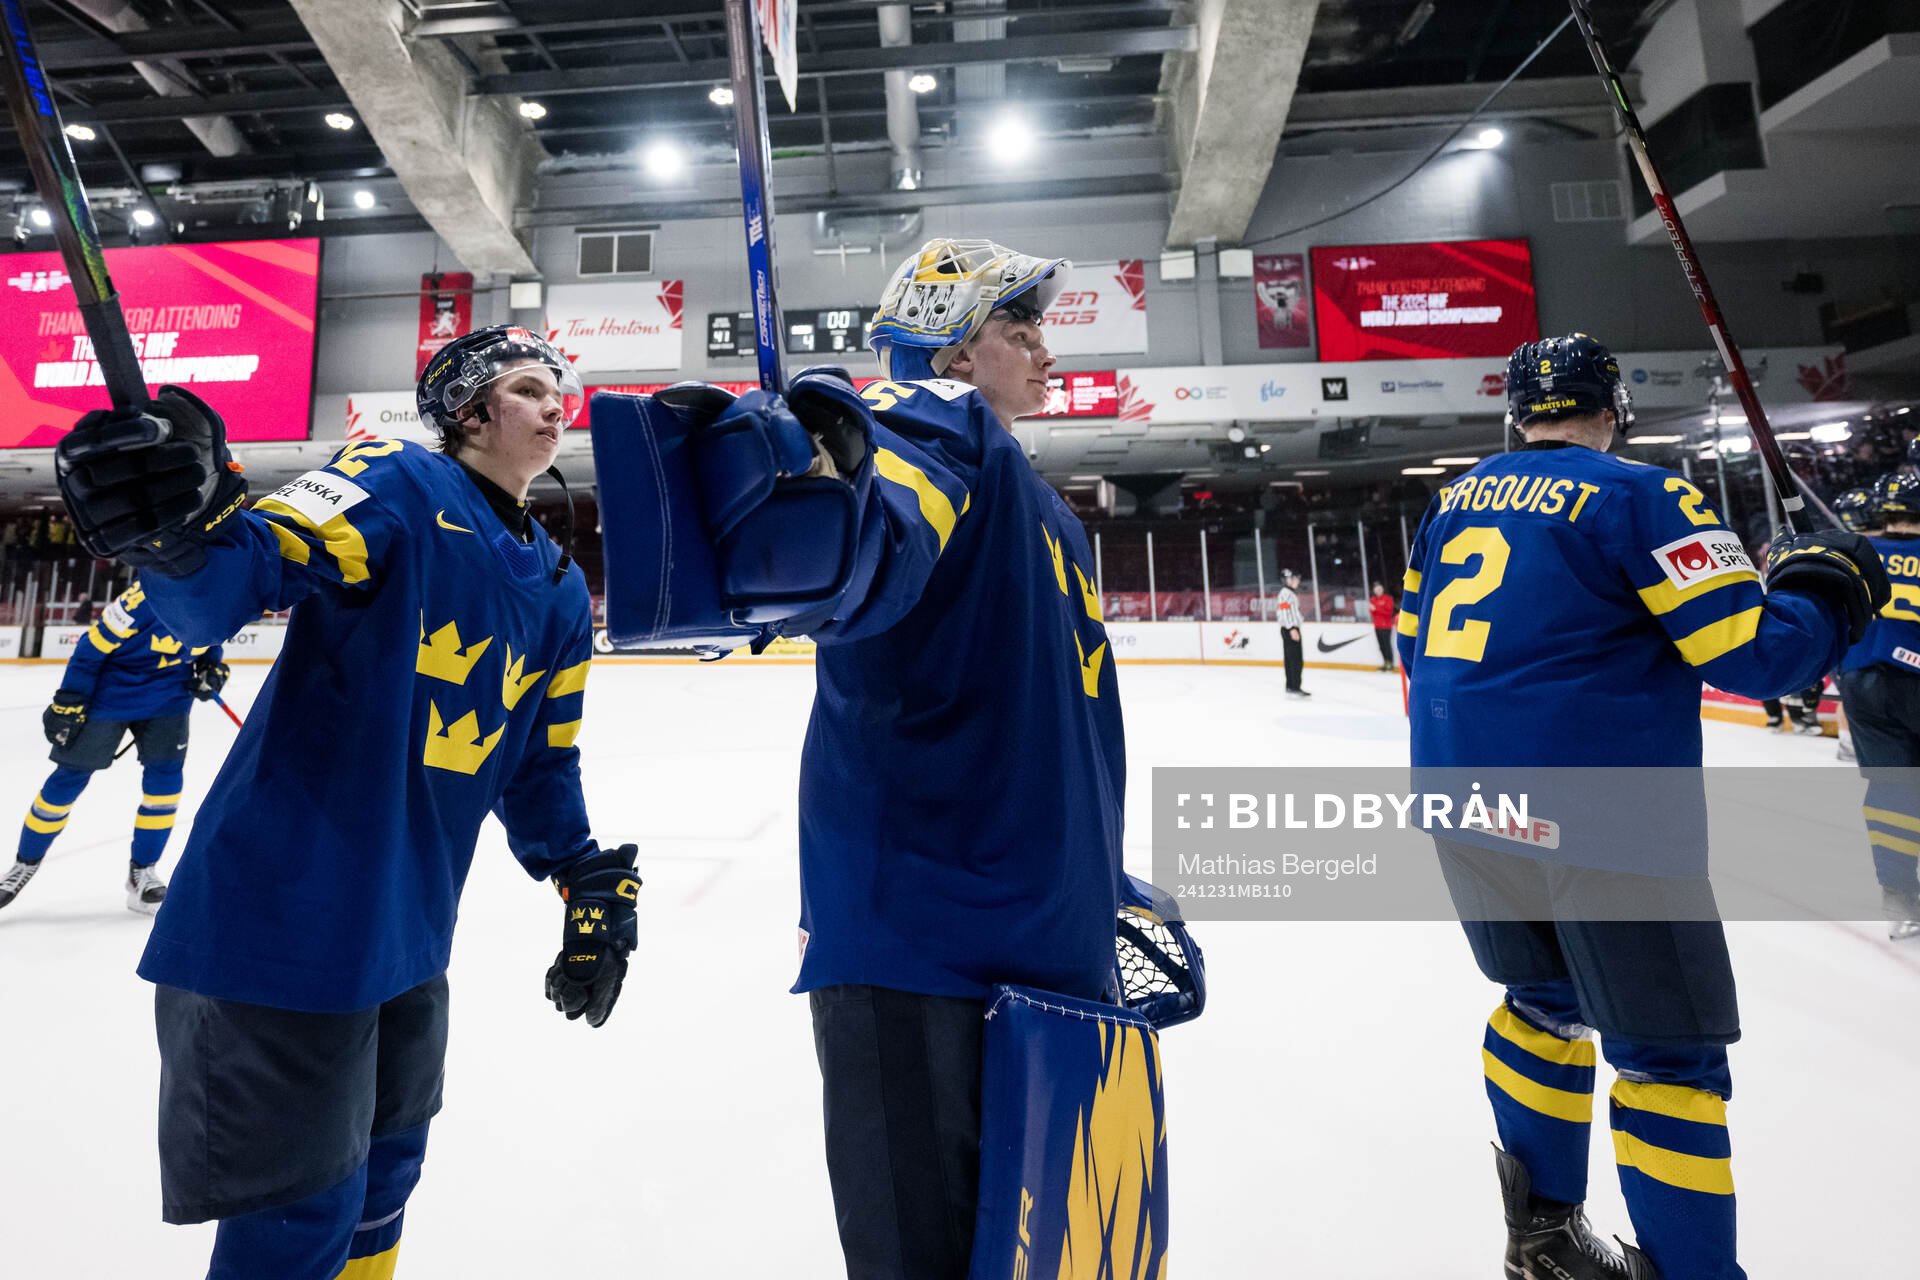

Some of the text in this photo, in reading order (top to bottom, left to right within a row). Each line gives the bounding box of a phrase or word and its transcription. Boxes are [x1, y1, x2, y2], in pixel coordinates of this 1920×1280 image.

[1055, 290, 1099, 307] SN
[154, 304, 242, 330] ATTENDING
[827, 311, 850, 329] 00
[567, 316, 661, 338] Tim Hortons
[803, 335, 814, 350] 4
[427, 358, 453, 385] CCM
[1540, 360, 1551, 374] 2
[1606, 364, 1621, 374] CC
[1326, 381, 1344, 395] W
[1562, 399, 1576, 407] LAG
[380, 410, 418, 424] Onta
[286, 478, 344, 506] ENSKA
[1663, 477, 1722, 526] 2
[1711, 543, 1746, 555] SVEN
[1720, 555, 1750, 567] SPEL
[1886, 554, 1920, 578] SO
[1424, 526, 1512, 663] 2
[568, 954, 598, 962] CCM
[1536, 1253, 1576, 1280] CC
